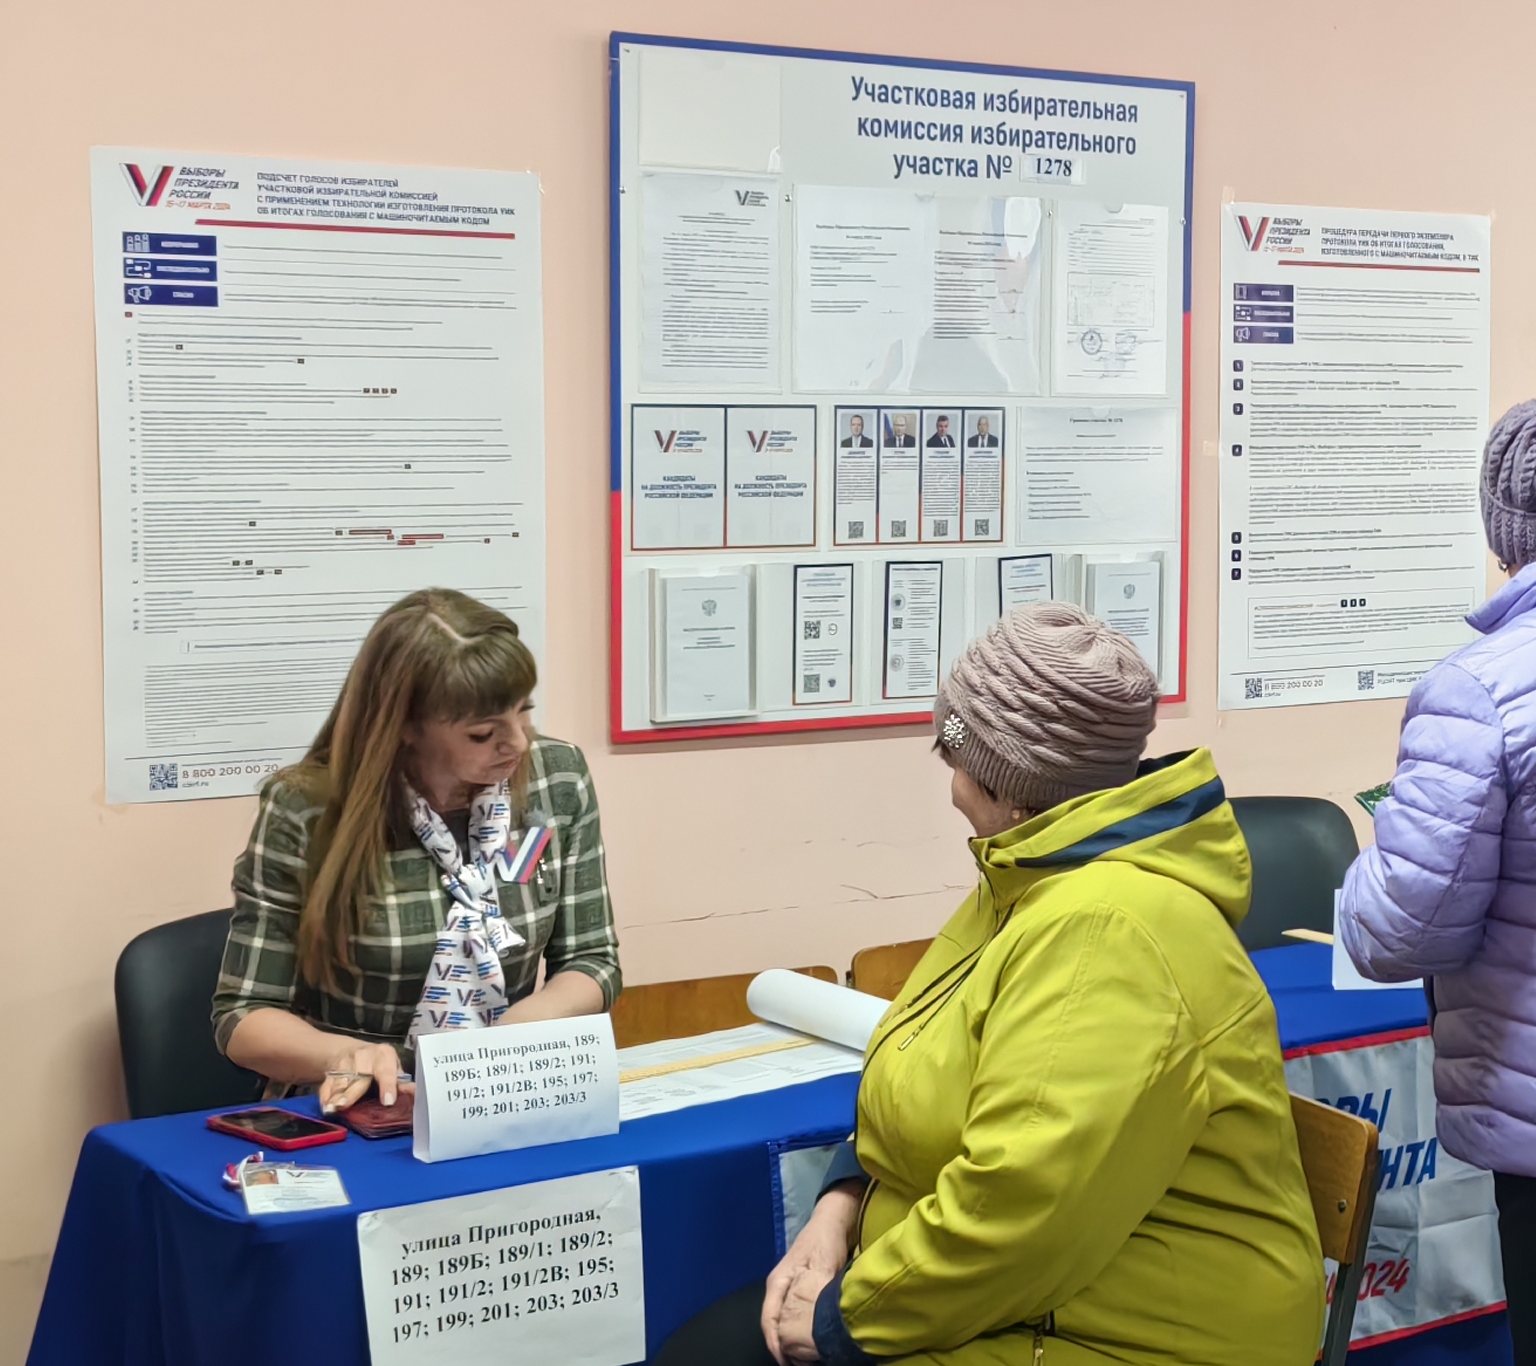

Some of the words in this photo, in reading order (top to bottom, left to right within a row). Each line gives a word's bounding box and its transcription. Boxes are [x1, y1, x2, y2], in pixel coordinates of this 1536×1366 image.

[851, 75, 976, 110] Участковая
[983, 89, 1138, 122] избирательная
[857, 117, 963, 143] комиссия
[971, 122, 1136, 155] избирательного
[179, 167, 226, 177] ВЫБОРЫ
[257, 172, 297, 182] ПОДСЧЕТ
[300, 174, 338, 185] ГОЛОСОВ
[341, 176, 398, 188] ИЗБИРАТЕЛЕЙ
[893, 154, 978, 179] участка
[986, 155, 1013, 179] №
[1035, 157, 1073, 177] 1278
[168, 189, 211, 199] РОССИИ
[174, 178, 239, 189] ПРЕЗИДЕНТА
[257, 184, 315, 195] УЧАСТКОВОЙ
[317, 186, 387, 199] ИЗБИРАТЕЛЬНОЙ
[389, 191, 438, 201] КОМИССИЕЙ
[257, 207, 269, 215] ОБ
[271, 208, 304, 217] ИТОГАХ
[306, 209, 367, 220] ГОЛОСОВАНИЯ
[461, 216, 489, 226] КОДОМ
[265, 196, 329, 206] ПРИМЕНЕНИЕМ
[332, 199, 385, 209] ТЕХНОЛОГИИ
[387, 201, 449, 213] ИЗГОТОВЛЕНИЯ
[451, 205, 498, 215] ПРОТОКОЛА
[193, 768, 215, 777] 800
[220, 766, 241, 776] 200
[245, 765, 260, 773] 00
[264, 764, 278, 772] 20
[432, 1051, 474, 1067] улица
[478, 1038, 571, 1061] Пригородная,
[574, 1034, 600, 1047] 189;
[444, 1068, 481, 1083] 189Б;
[486, 1063, 524, 1077] 189/1;
[529, 1057, 566, 1071] 189/2;
[571, 1053, 596, 1066] 191;
[447, 1087, 485, 1102] 191/2;
[490, 1080, 537, 1096] 191/2В;
[542, 1075, 568, 1089] 195;
[572, 1071, 598, 1085] 197;
[462, 1105, 488, 1119] 199;
[493, 1101, 519, 1115] 201;
[524, 1097, 550, 1111] 203;
[554, 1091, 587, 1106] 203/3
[401, 1233, 461, 1259] улица
[468, 1208, 601, 1244] Пригородная,
[392, 1264, 429, 1285] 189;
[438, 1253, 490, 1276] 189Б;
[498, 1242, 552, 1265] 189/1;
[560, 1230, 612, 1253] 189/2;
[394, 1293, 430, 1314] 191;
[439, 1280, 493, 1304] 191/2;
[502, 1265, 569, 1292] 191/2В;
[577, 1256, 614, 1277] 195;
[1356, 1258, 1409, 1302] 024
[393, 1321, 429, 1343] 197;
[437, 1311, 474, 1333] 199;
[481, 1301, 520, 1323] 201;
[526, 1293, 565, 1314] 203;
[571, 1281, 619, 1306] 203/3
